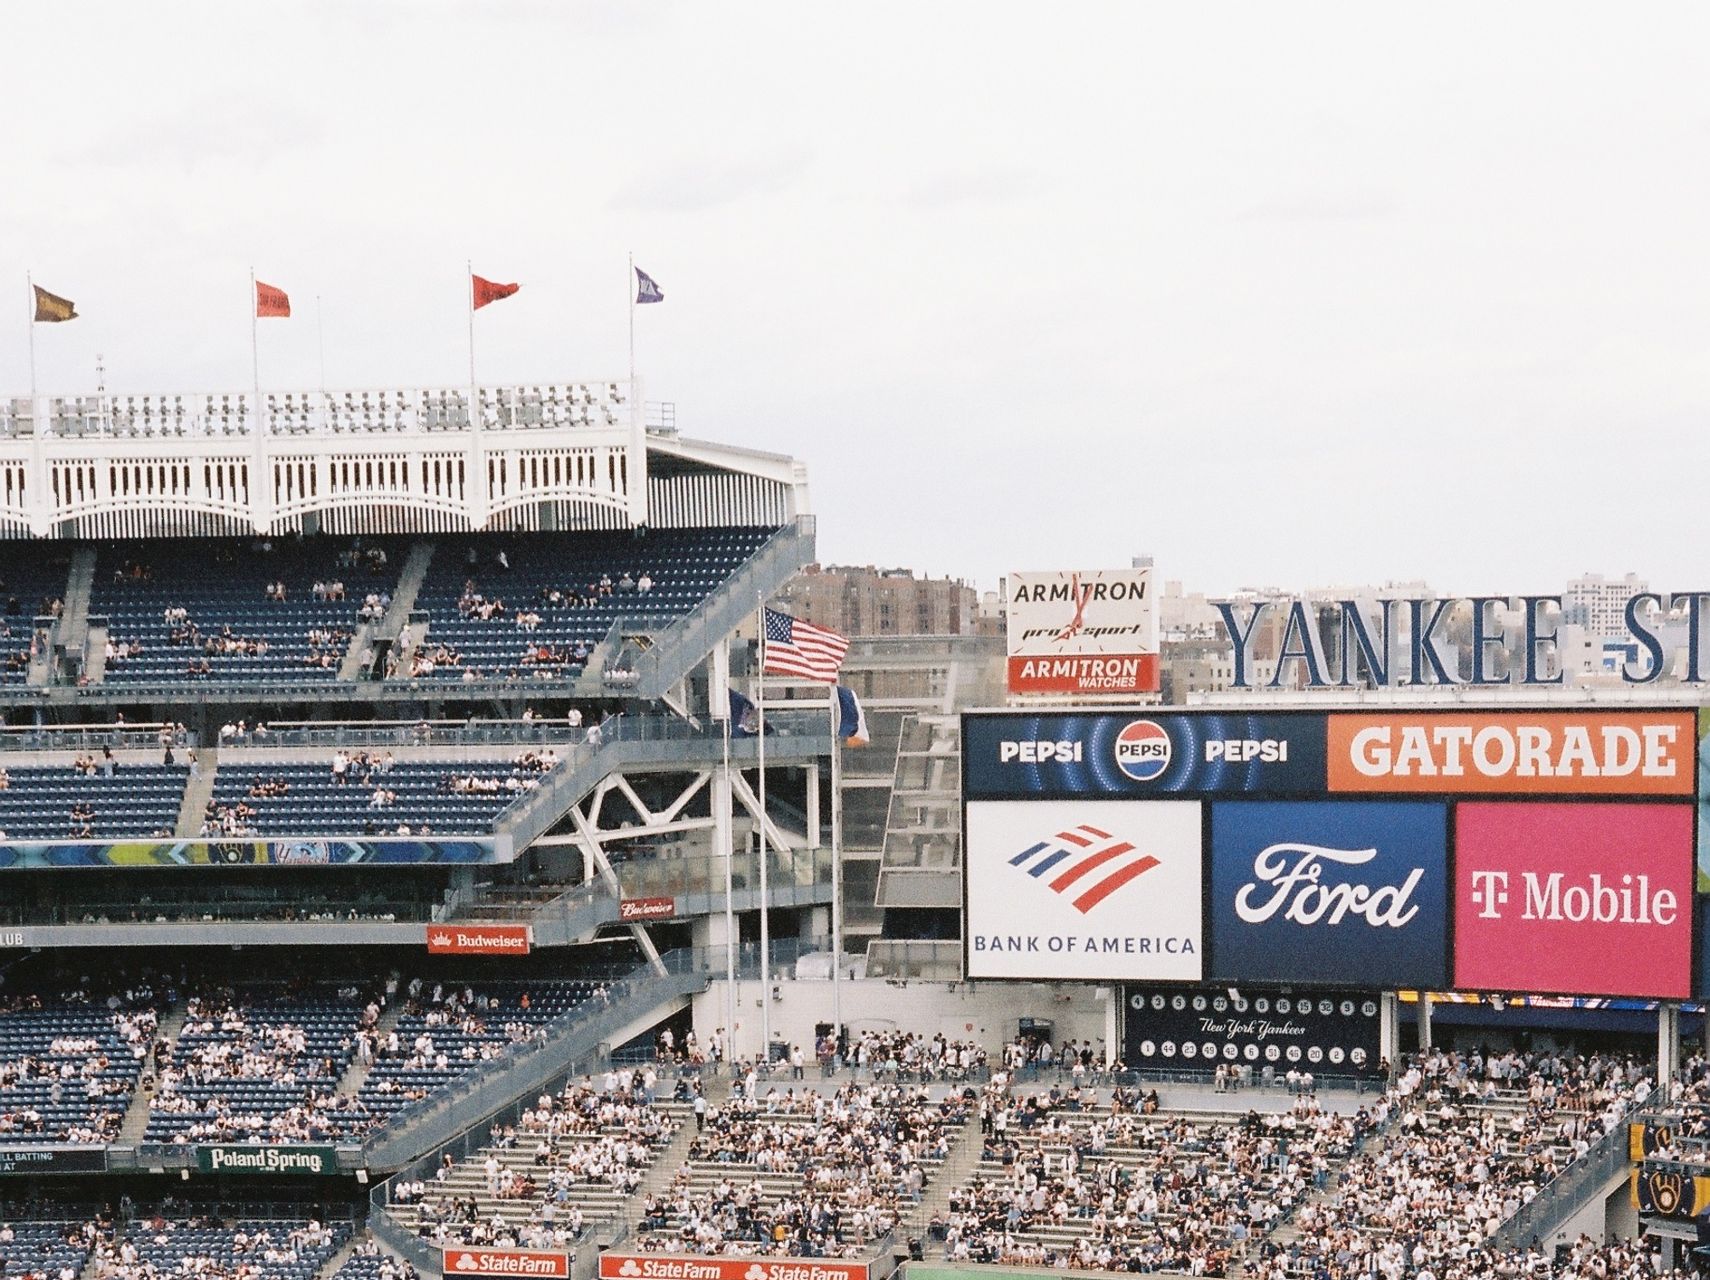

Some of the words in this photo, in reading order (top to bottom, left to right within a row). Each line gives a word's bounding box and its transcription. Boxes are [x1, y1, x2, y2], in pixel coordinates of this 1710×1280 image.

[1014, 581, 1146, 603] ARMITRON
[1082, 624, 1141, 638] sport
[1211, 595, 1565, 689] YANKEE
[1020, 658, 1138, 679] ARMITRON
[1078, 676, 1137, 688] WATCHES
[1000, 740, 1082, 763] PEPSI
[1119, 743, 1168, 757] PEPSI
[1205, 739, 1288, 763] PEPSI
[1350, 725, 1677, 777] GATORADE
[1234, 842, 1425, 928] Ford
[620, 900, 675, 917] Budweiser
[1521, 872, 1677, 926] Mobile
[457, 933, 524, 947] Budweiser
[974, 935, 1039, 952] BANK
[1048, 936, 1077, 952] OF
[1084, 937, 1195, 954] AMERICA
[1199, 1017, 1227, 1032] New
[1226, 1019, 1256, 1040] York
[1257, 1020, 1306, 1041] Yankees
[15, 1152, 54, 1161] BATTING
[211, 1148, 266, 1169] Poland
[266, 1149, 322, 1172] Spring
